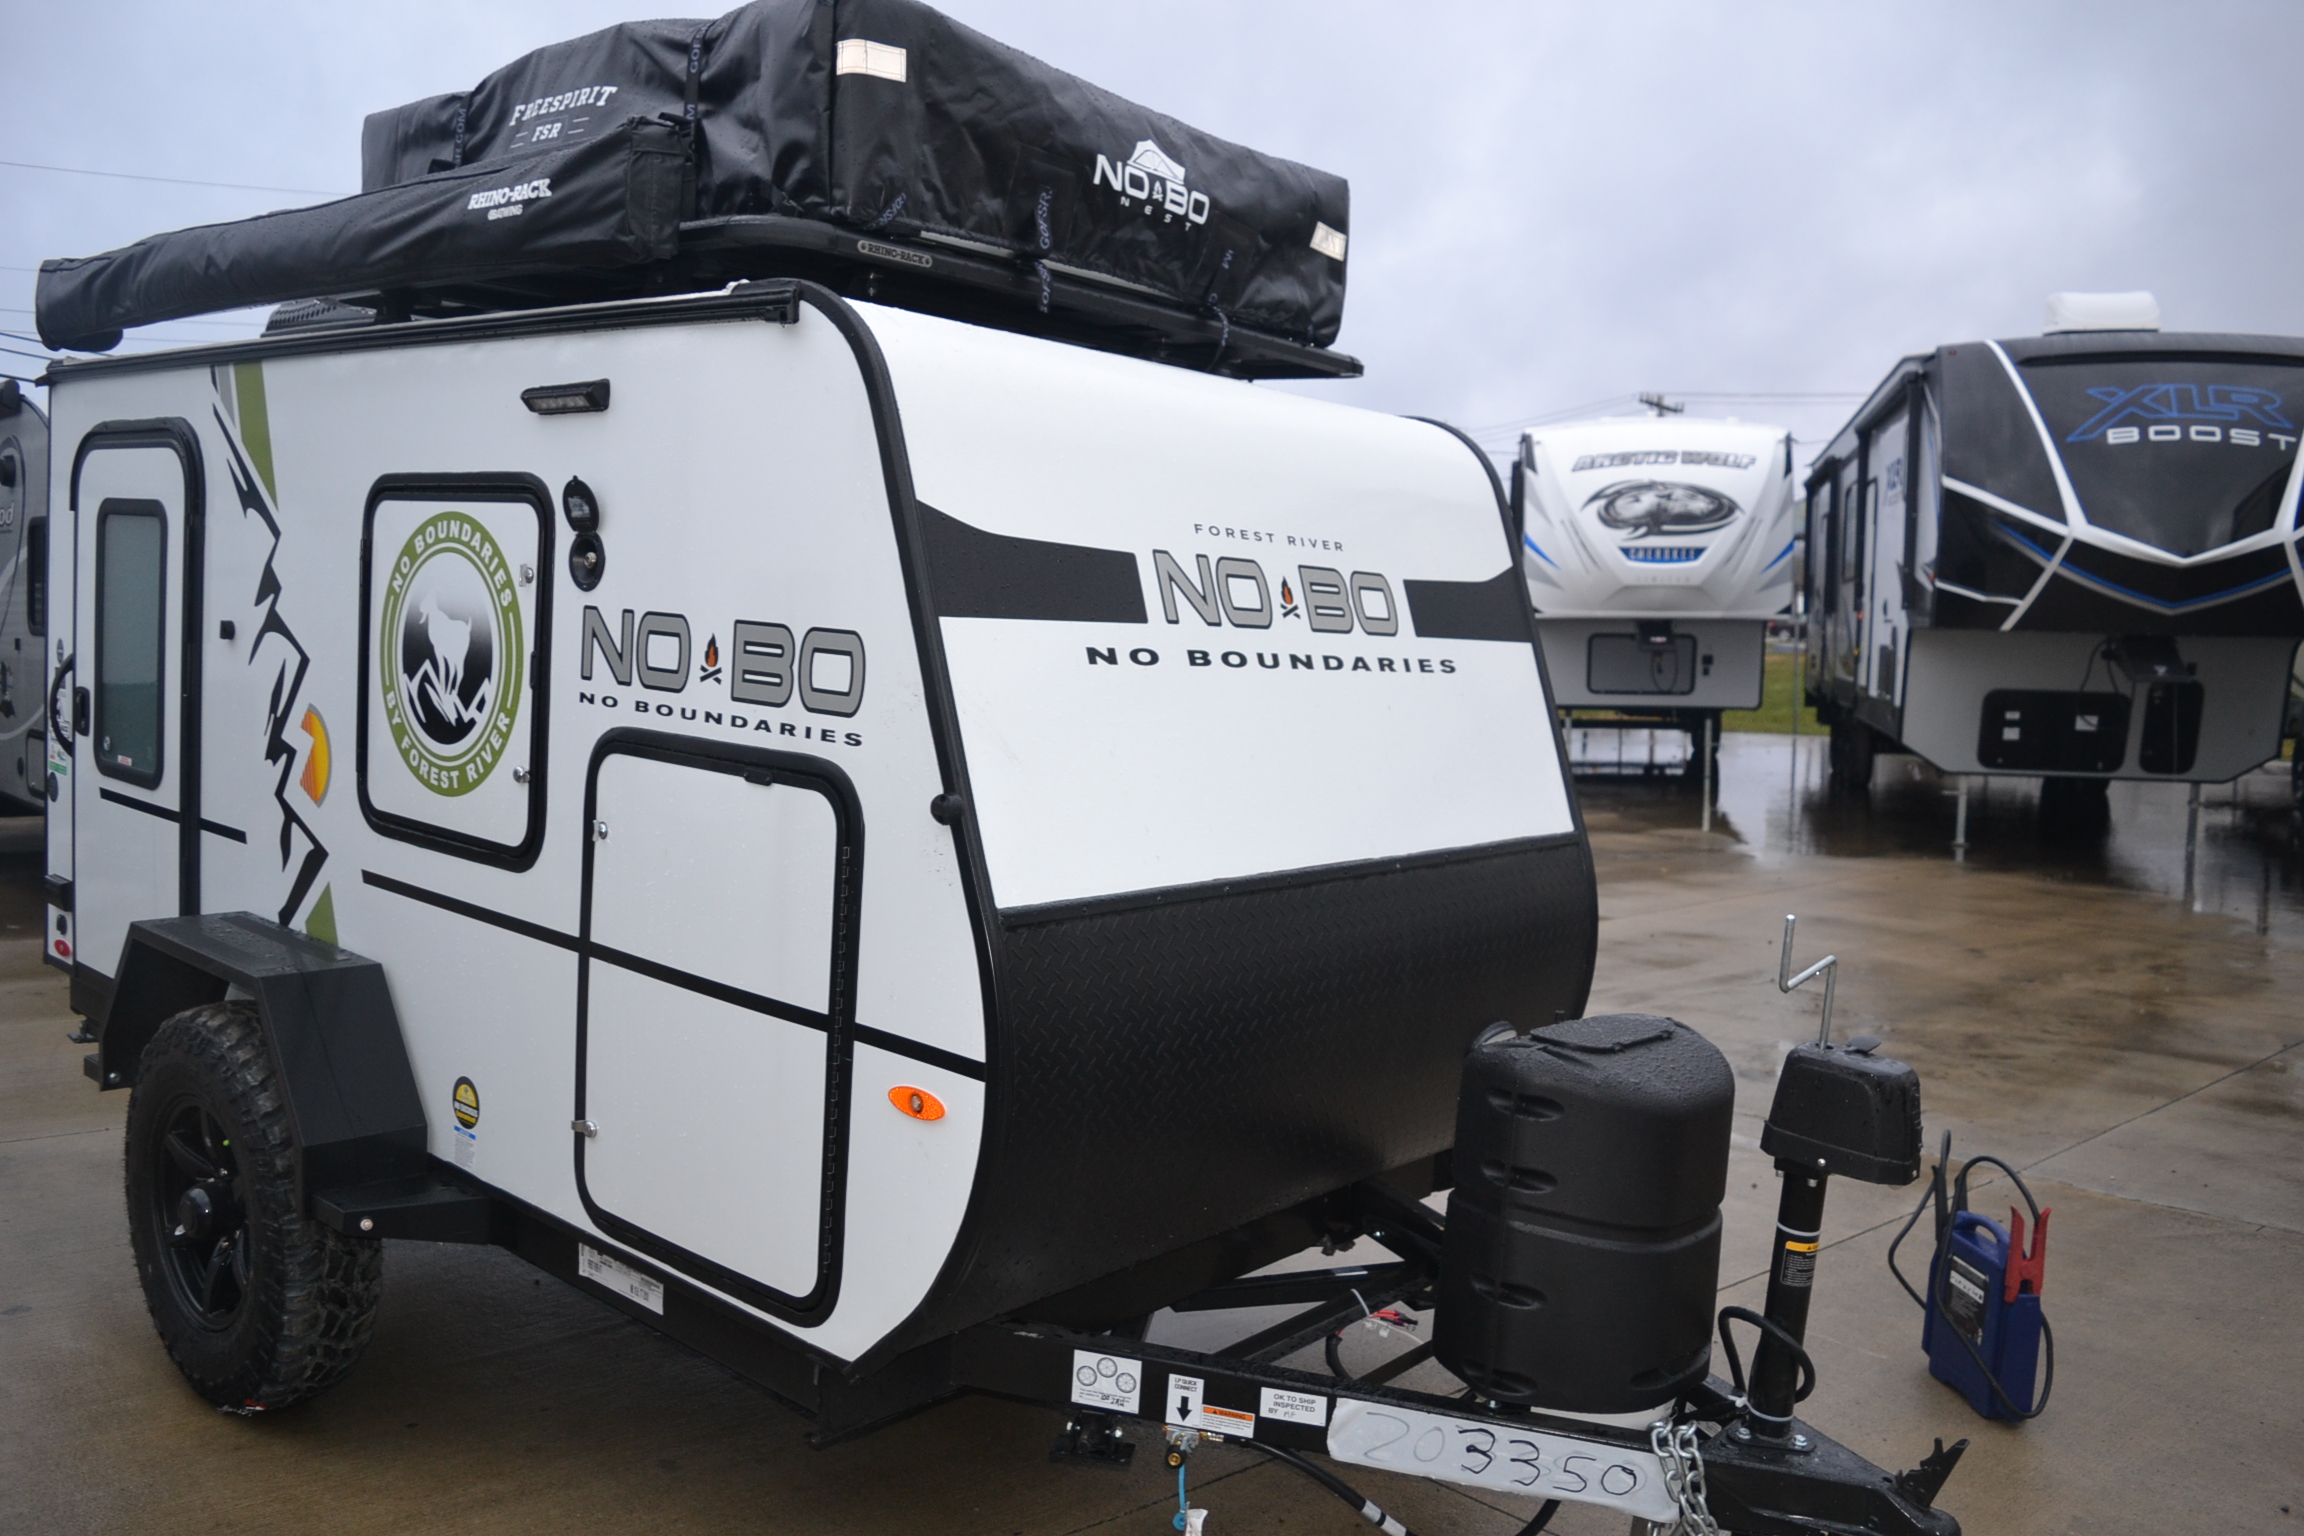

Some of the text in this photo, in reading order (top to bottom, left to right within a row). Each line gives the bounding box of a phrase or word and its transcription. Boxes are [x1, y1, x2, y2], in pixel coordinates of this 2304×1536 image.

[510, 85, 619, 126] FREESPIRIT
[531, 122, 563, 142] FSR
[467, 178, 552, 210] RHINO-RACK
[1120, 196, 1191, 232] NEST
[867, 243, 925, 265] RHINO-RACK
[2065, 383, 2294, 442] XLR
[2106, 425, 2298, 451] BOOST
[1571, 450, 1757, 473] ARCTIC WOLF
[1194, 523, 1344, 552] FOREST RIVER
[392, 519, 512, 607] NO BOUNDARIES
[1086, 646, 1457, 674] NO BOUNDARIES
[579, 692, 863, 747] NO BOUNDARIES
[386, 690, 510, 789] BY FOREST RIVER
[1268, 1407, 1279, 1415] BY
[1273, 1394, 1316, 1405] OK TO SHIP
[1273, 1401, 1316, 1413] INSPECTED
